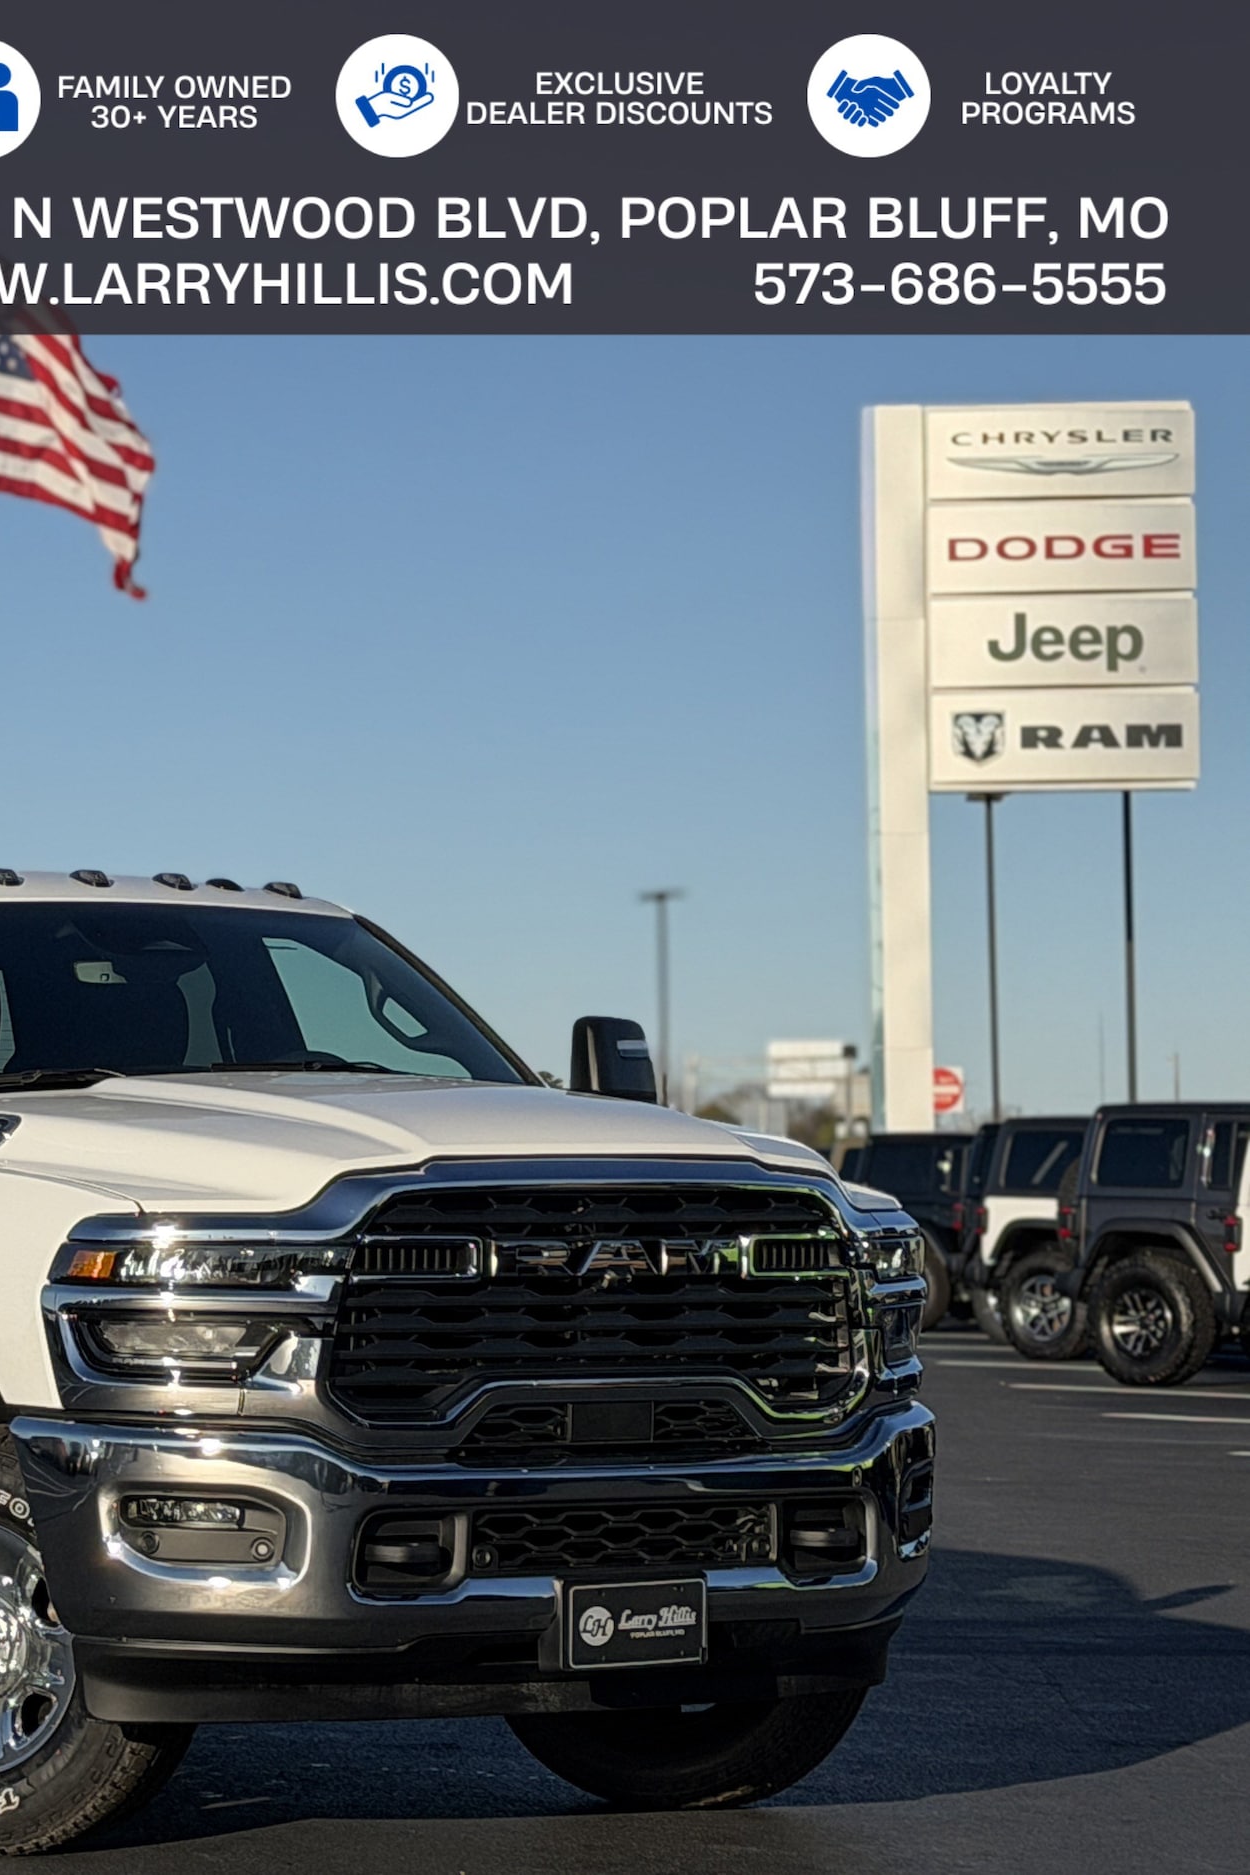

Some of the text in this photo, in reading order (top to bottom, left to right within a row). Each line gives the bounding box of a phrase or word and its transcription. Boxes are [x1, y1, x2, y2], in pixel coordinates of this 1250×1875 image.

[951, 428, 1174, 446] CHRYSLER
[948, 534, 1181, 561] DODGE
[987, 613, 1144, 672] Jeep
[1020, 724, 1184, 750] RAM
[618, 1604, 697, 1631] Larry Hillis
